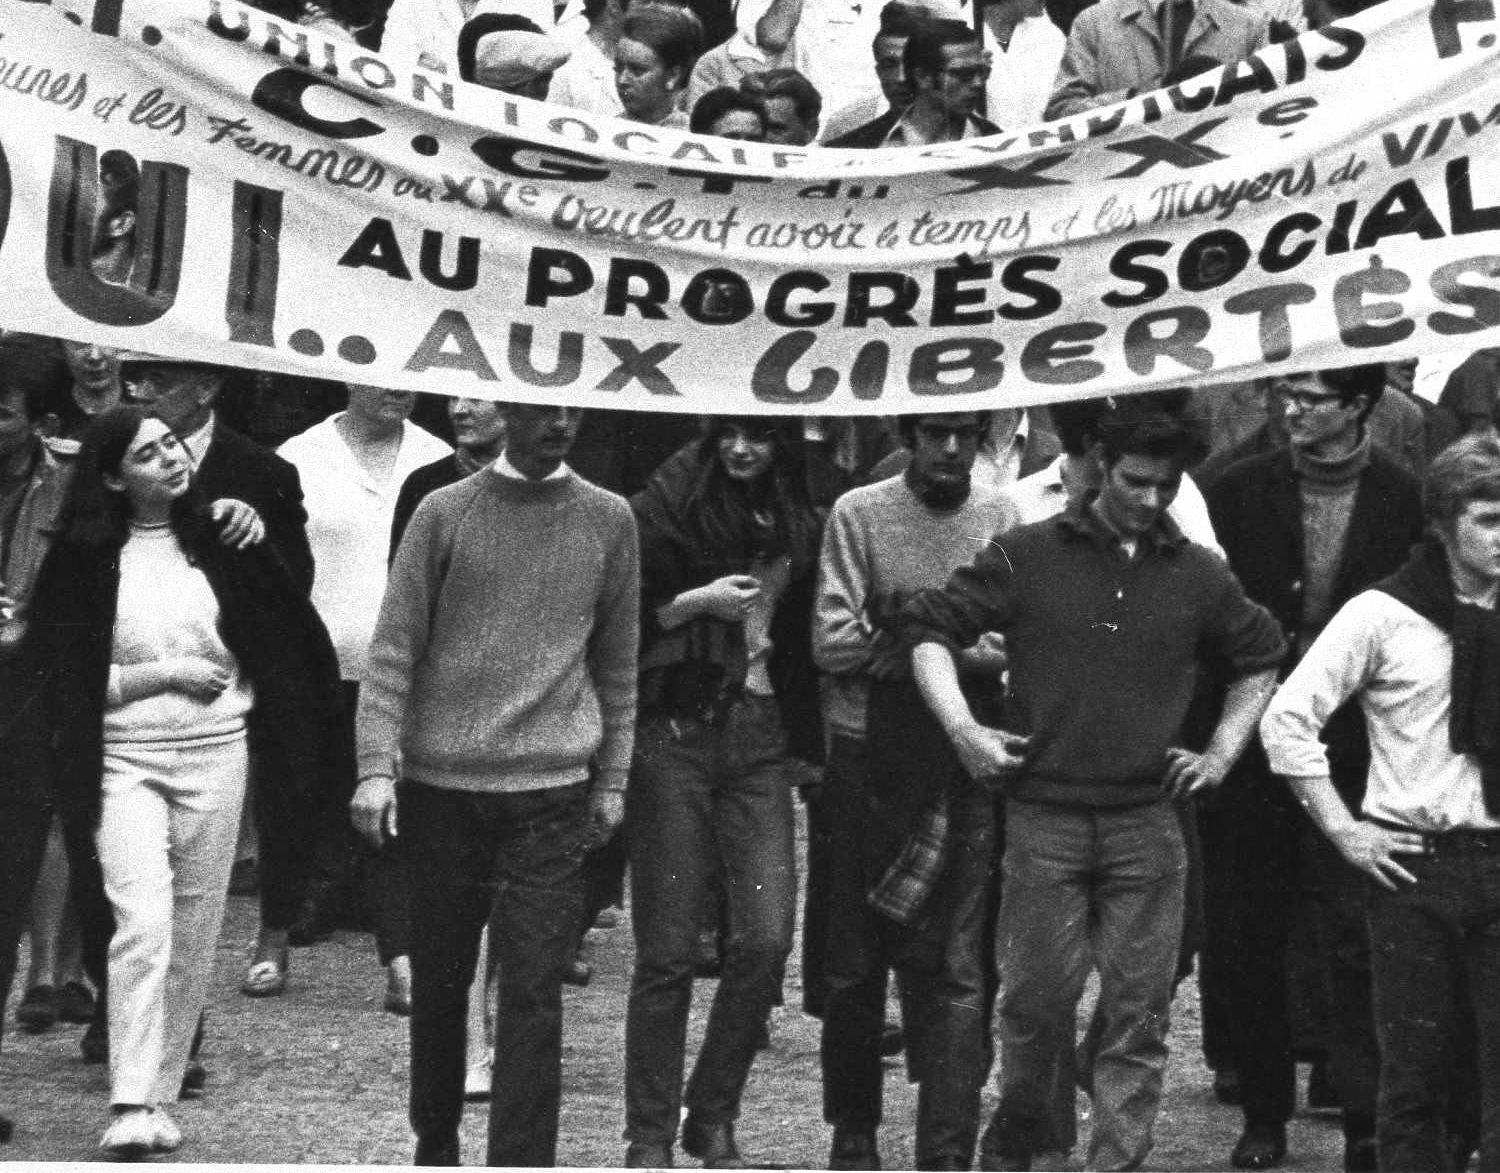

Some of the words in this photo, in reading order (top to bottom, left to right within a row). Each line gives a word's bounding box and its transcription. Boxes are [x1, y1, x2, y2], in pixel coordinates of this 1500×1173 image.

[93, 92, 128, 124] et
[129, 86, 188, 137] les
[551, 192, 741, 250] veulent
[745, 207, 867, 251] avoir
[908, 209, 1031, 258] temps
[1094, 193, 1138, 234] les
[1327, 152, 1369, 187] de
[337, 216, 482, 293] AU
[525, 246, 1064, 330] PROGRÈS
[403, 309, 683, 399] AUX
